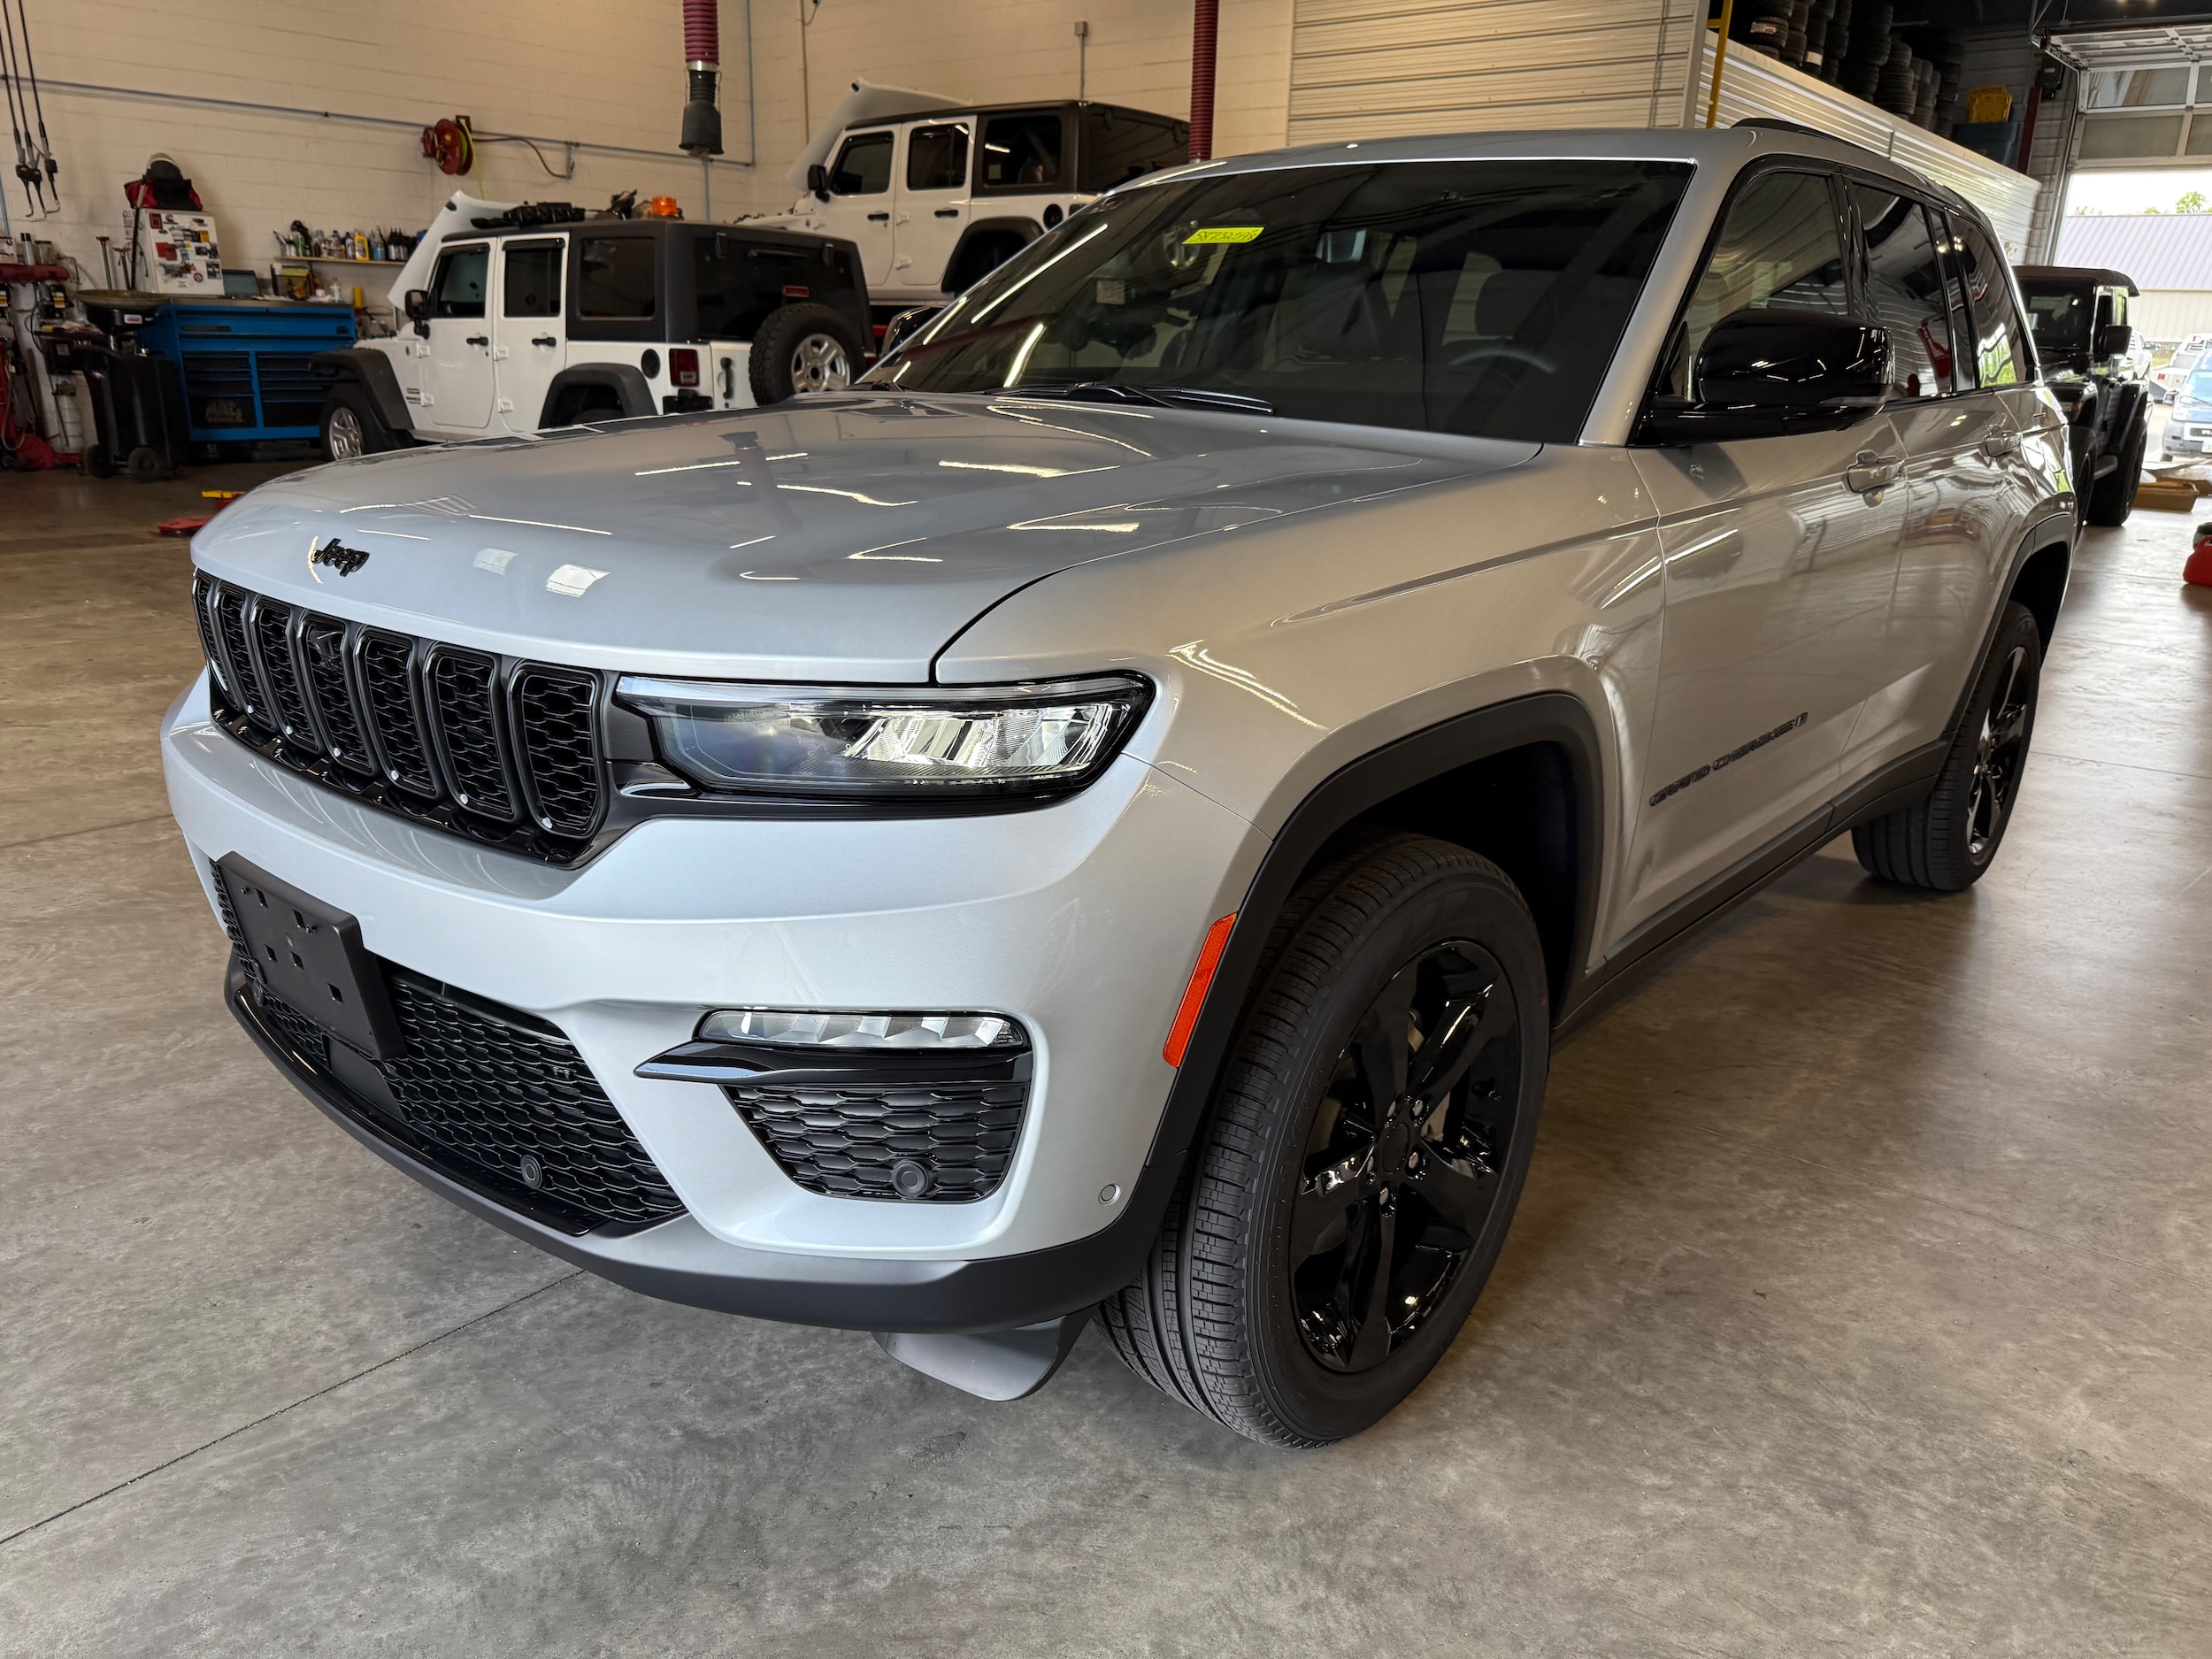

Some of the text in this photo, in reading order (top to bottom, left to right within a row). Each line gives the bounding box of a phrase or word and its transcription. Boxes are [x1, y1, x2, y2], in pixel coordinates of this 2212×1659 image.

[311, 538, 370, 578] Jeep
[1648, 711, 1809, 807] GRAND CHEROKEE
